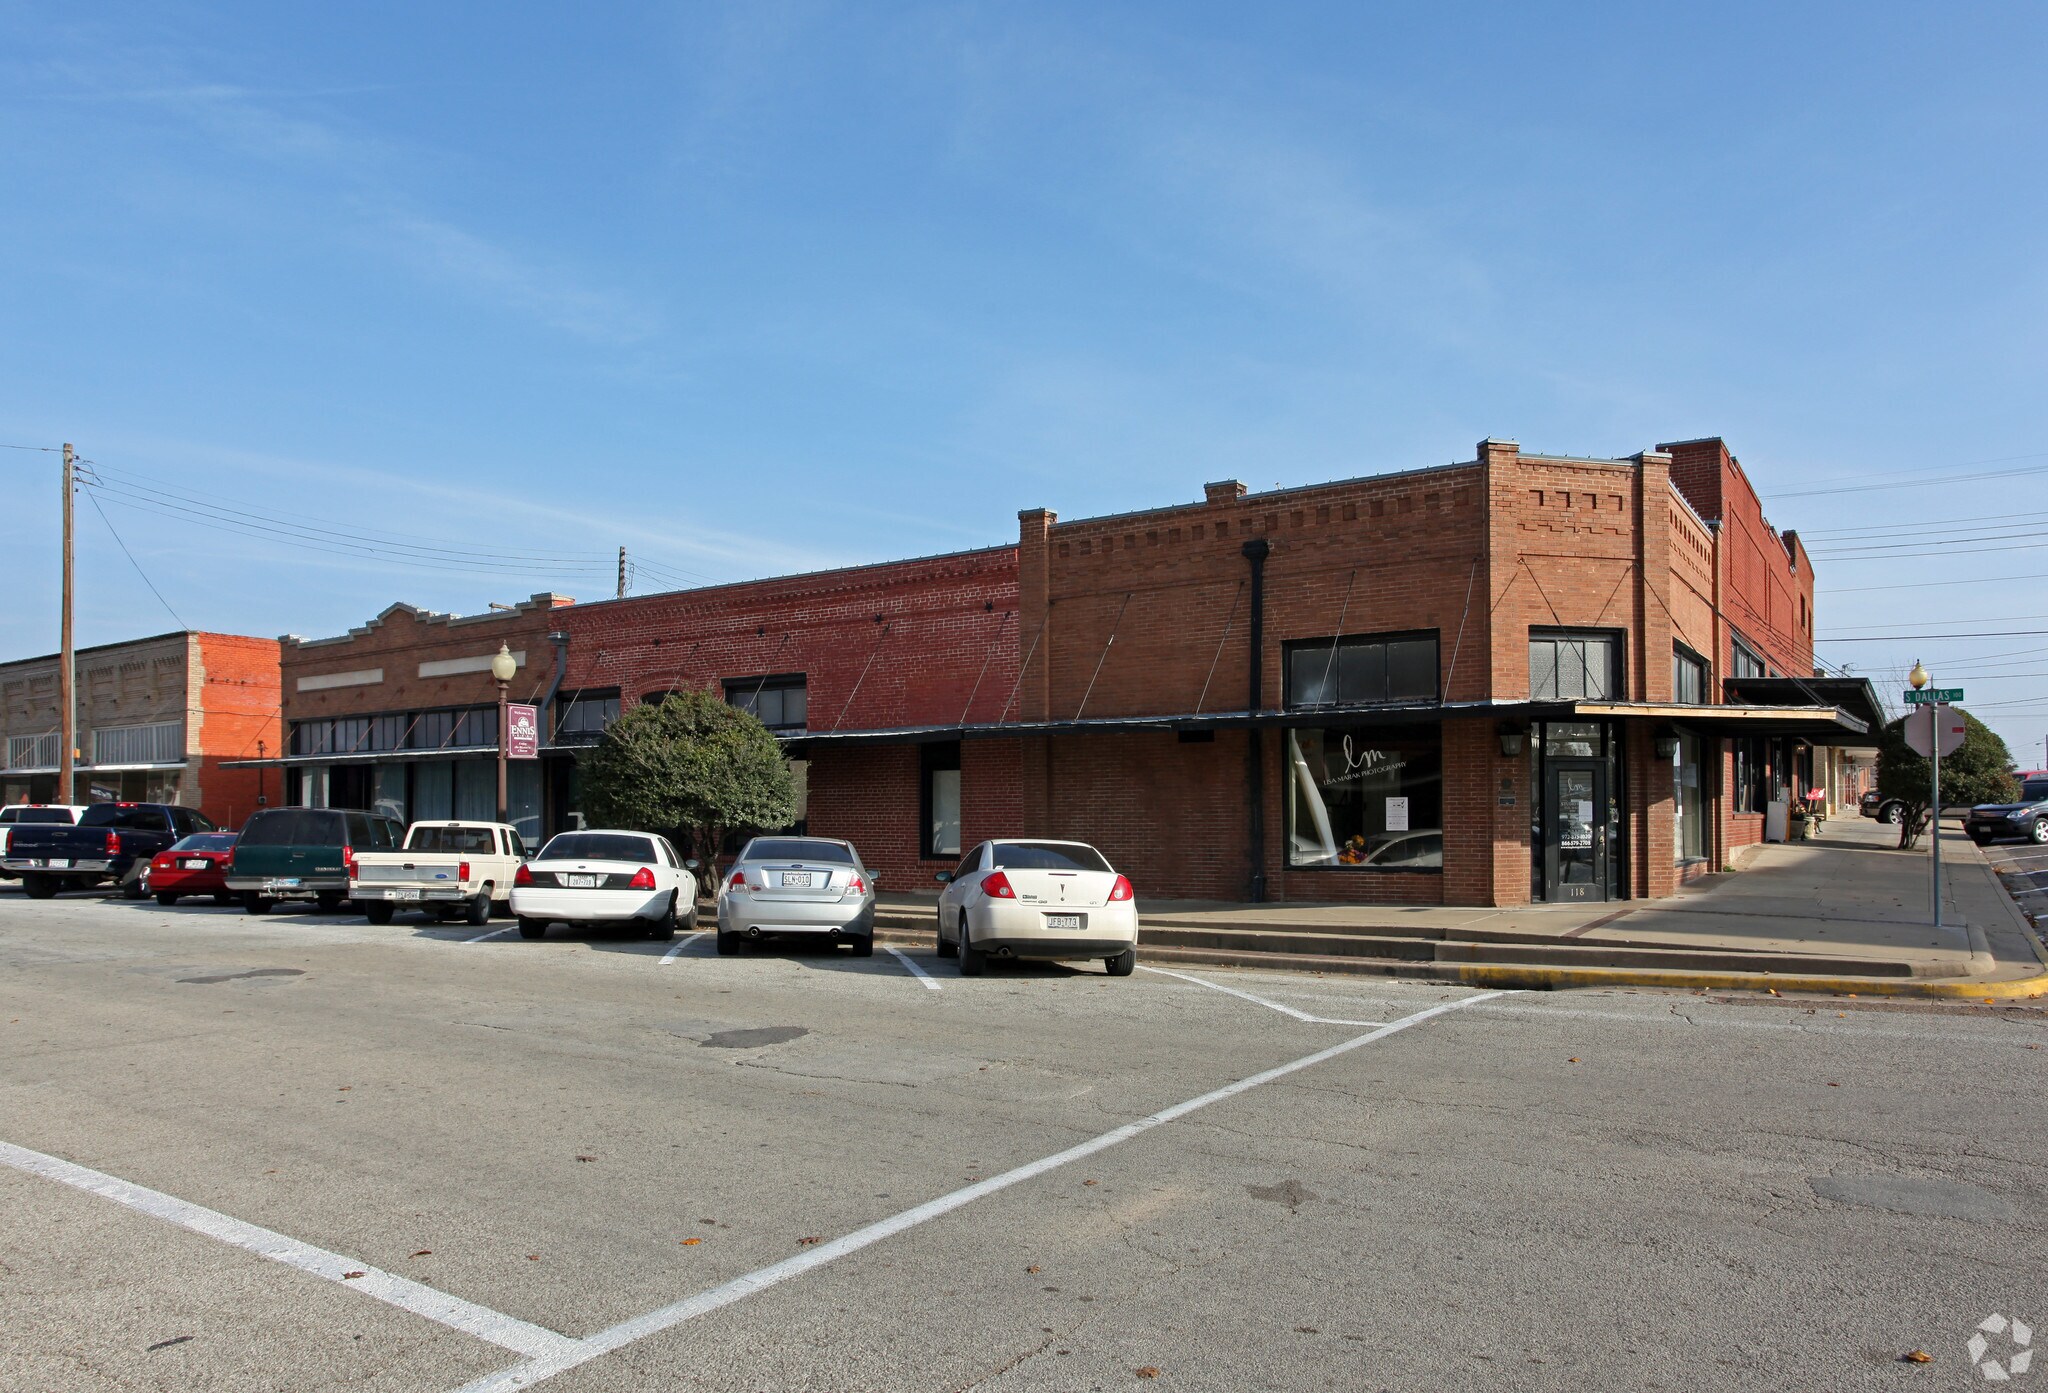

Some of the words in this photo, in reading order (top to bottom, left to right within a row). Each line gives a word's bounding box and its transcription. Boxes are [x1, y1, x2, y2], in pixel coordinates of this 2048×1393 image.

[1905, 692, 1911, 703] S
[1915, 690, 1950, 702] DALLAS
[511, 724, 535, 736] ENNIS
[1323, 777, 1338, 786] LISA
[1337, 772, 1361, 783] MARAK
[1361, 761, 1407, 777] PHOTOGRAPHY
[1570, 887, 1585, 897] 118
